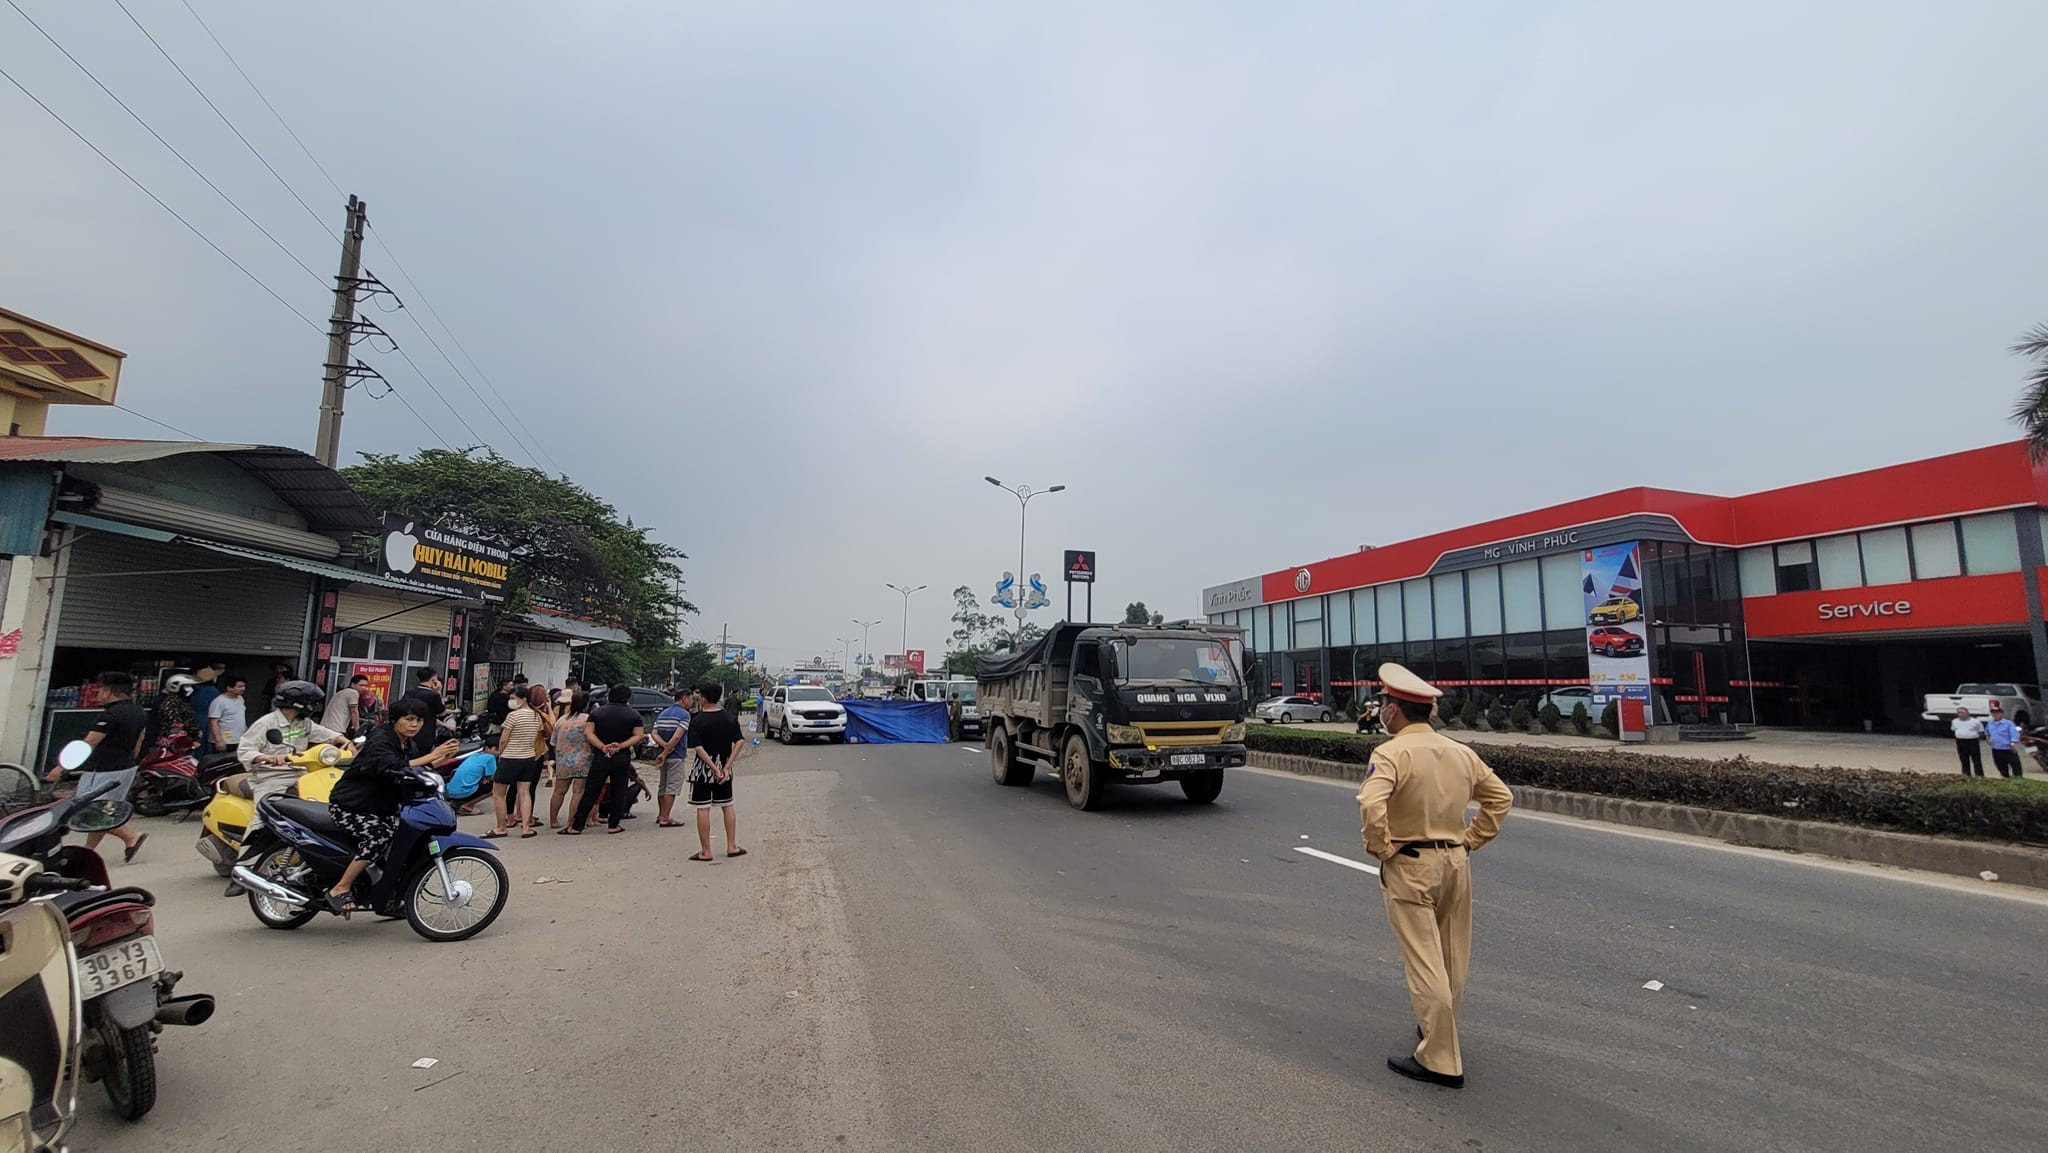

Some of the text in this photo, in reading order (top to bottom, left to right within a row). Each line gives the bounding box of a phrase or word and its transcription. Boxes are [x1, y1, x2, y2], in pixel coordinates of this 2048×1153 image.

[425, 528, 509, 561] CỬA HÀNG ĐIỆN THOẠI
[1484, 547, 1500, 560] MG
[1544, 531, 1578, 548] PHÚC
[415, 544, 508, 581] HUY HẢI MOBILE
[1228, 586, 1252, 602] Phúc
[1818, 600, 1911, 620] Service
[1137, 693, 1227, 703] QUANG NGA VLXD
[84, 943, 144, 975] 30-Y3
[91, 958, 147, 991] 3367
